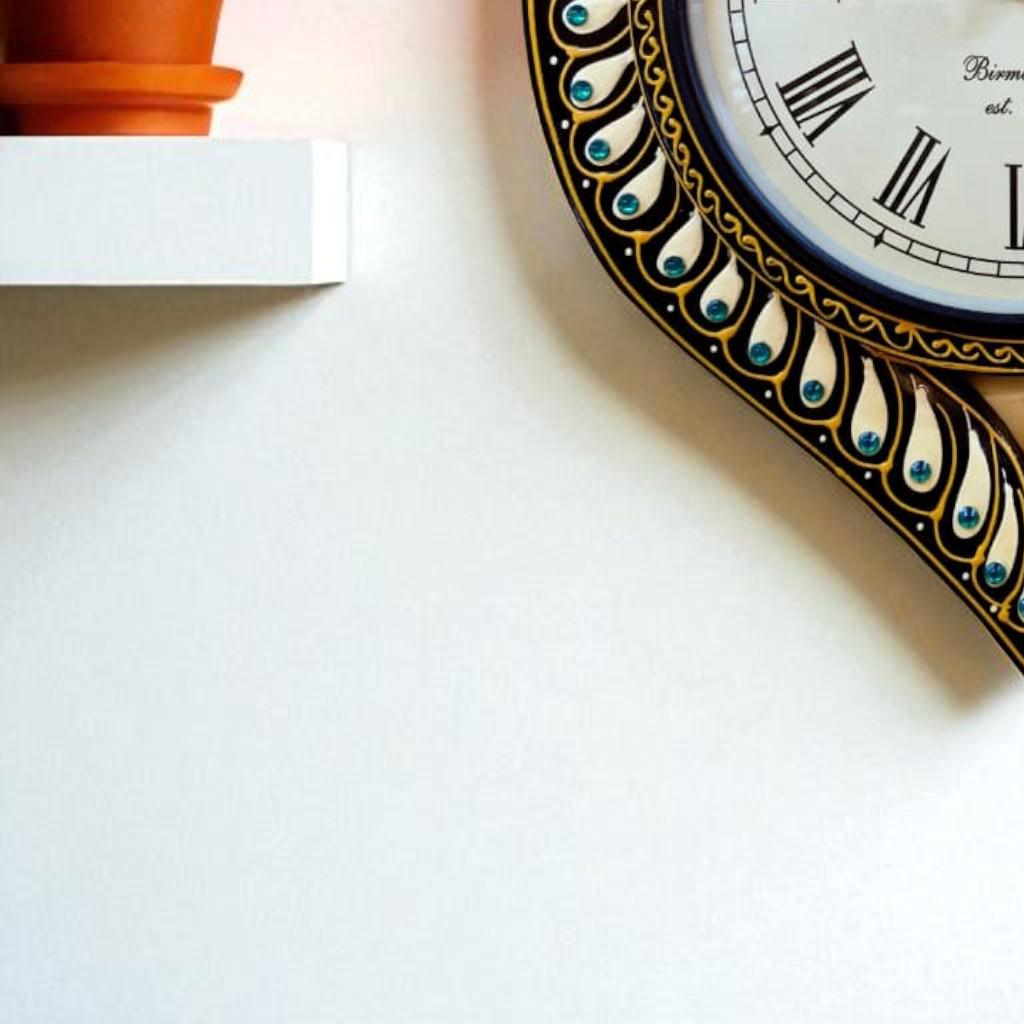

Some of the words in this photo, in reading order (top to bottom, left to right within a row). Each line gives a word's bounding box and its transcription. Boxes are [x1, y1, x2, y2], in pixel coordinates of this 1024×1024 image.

[776, 40, 876, 148] VIII
[985, 97, 1013, 115] est.
[872, 125, 952, 228] VII
